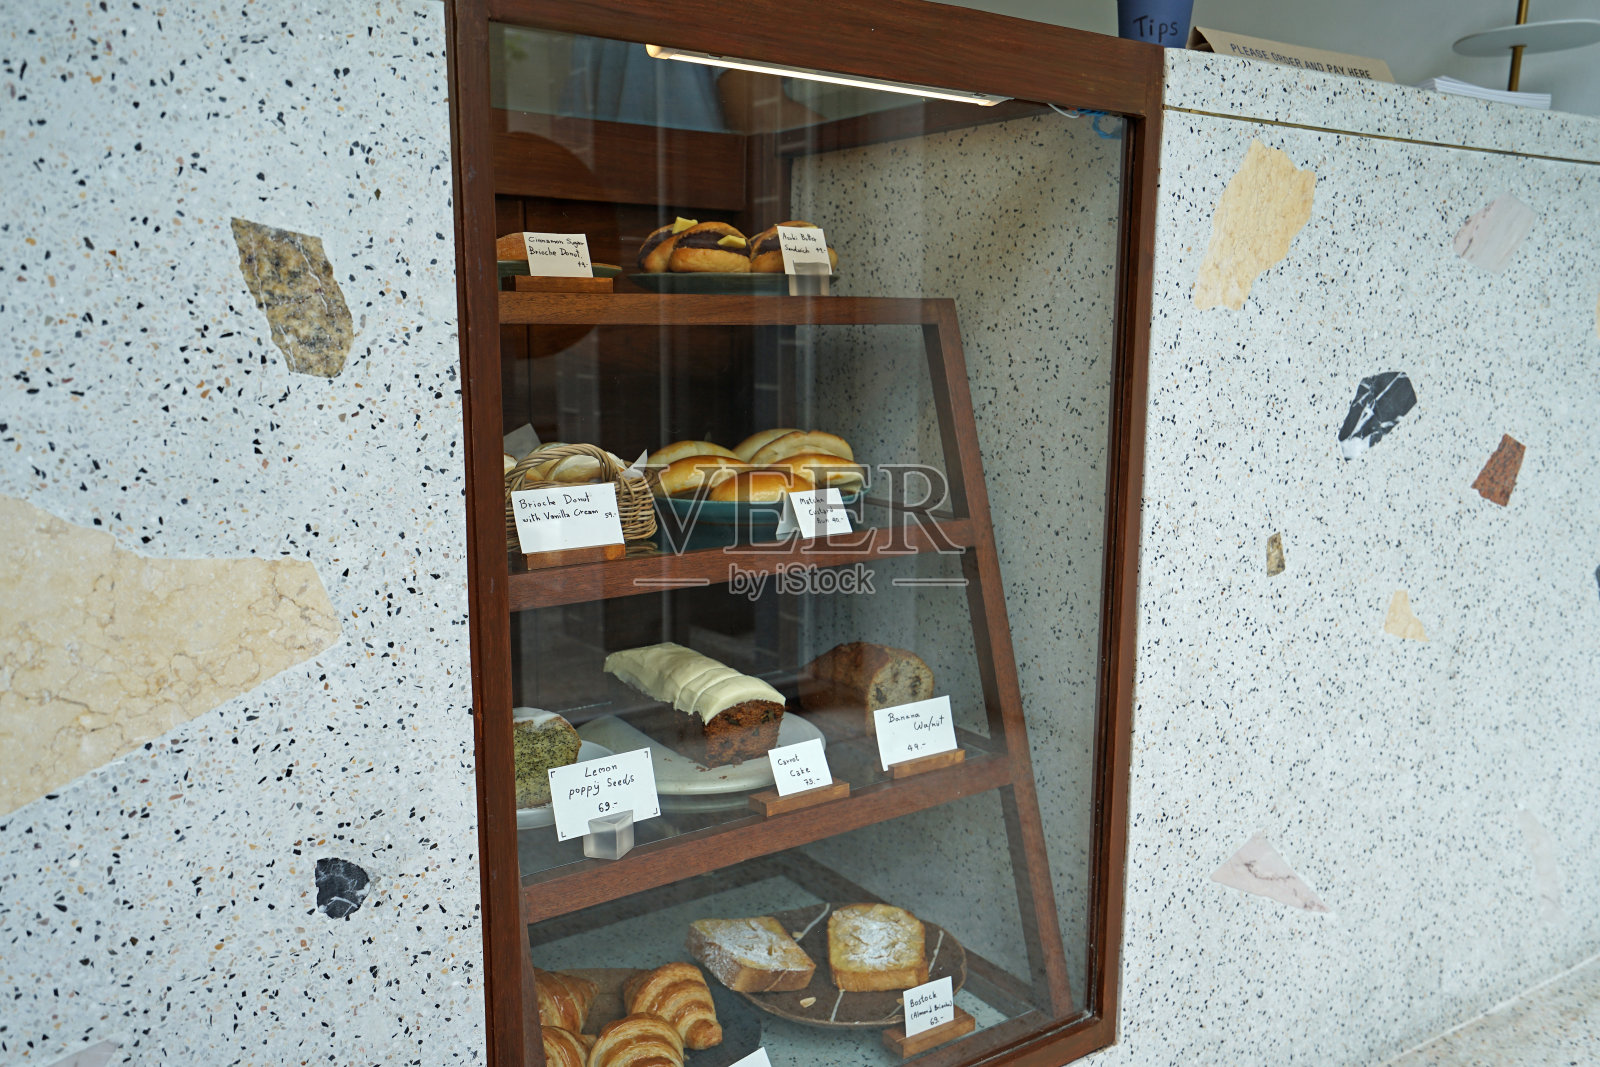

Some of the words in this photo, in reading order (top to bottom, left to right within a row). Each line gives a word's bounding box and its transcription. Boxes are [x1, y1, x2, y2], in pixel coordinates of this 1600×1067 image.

[1133, 15, 1178, 43] Tips
[1230, 43, 1270, 60] PLEASE
[1271, 52, 1301, 68] ORDER
[1304, 61, 1325, 72] AND
[1326, 64, 1345, 75] PAY
[1347, 67, 1373, 80] HERE
[528, 236, 564, 245] Cinnamon
[528, 245, 557, 256] Brioche
[785, 244, 810, 254] Sandwich
[519, 496, 556, 510] Brioche
[563, 492, 591, 505] Donut
[522, 513, 541, 523] with
[543, 509, 571, 520] Vanilla
[573, 508, 599, 517] Cream
[888, 712, 920, 723] Banana
[913, 714, 945, 731] Walnut
[777, 753, 800, 766] Carrot
[584, 764, 618, 778] Lemon
[789, 767, 811, 777] Cake
[568, 780, 600, 800] poppy
[607, 774, 635, 788] Seeds
[910, 991, 937, 1007] Bostock
